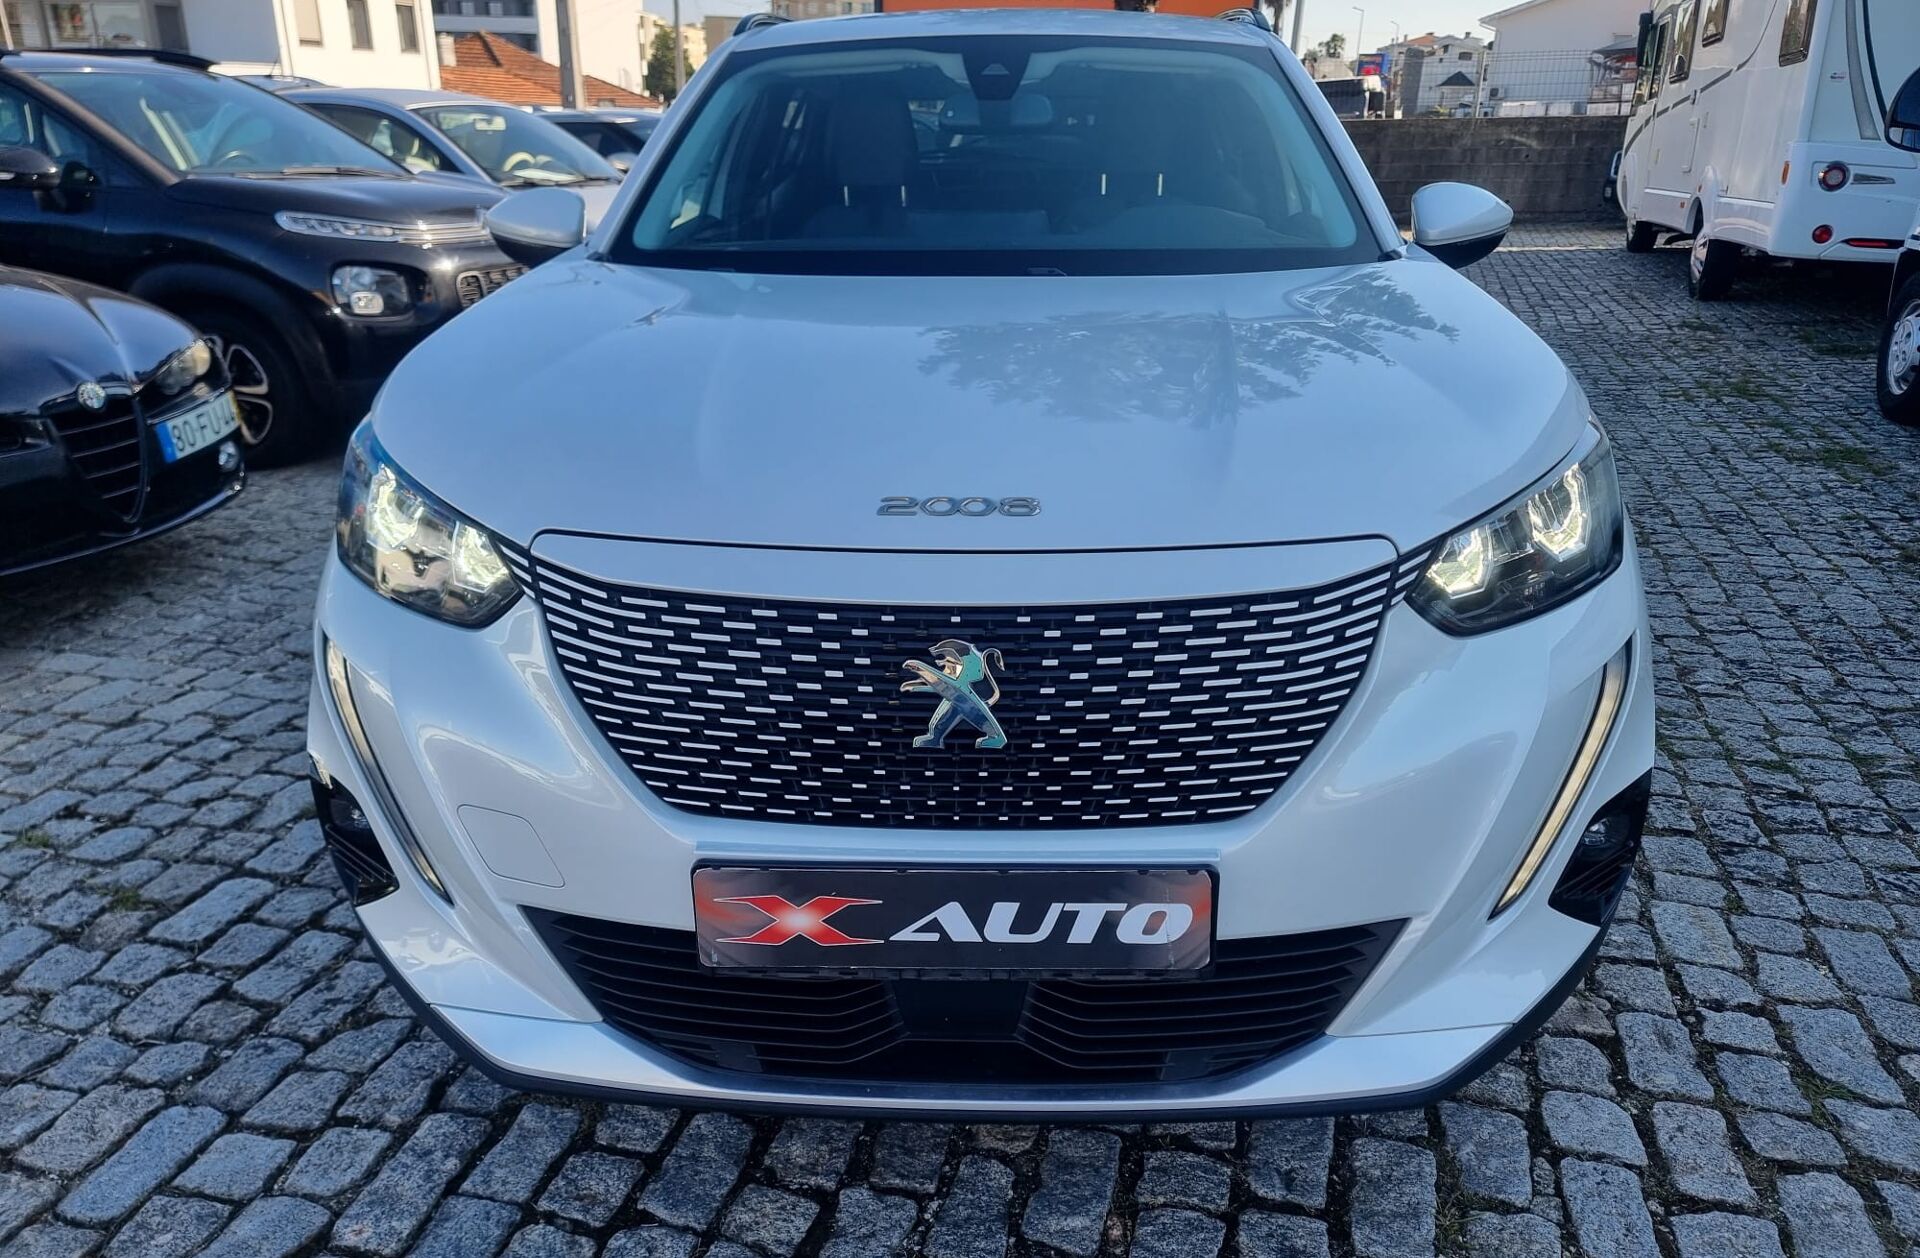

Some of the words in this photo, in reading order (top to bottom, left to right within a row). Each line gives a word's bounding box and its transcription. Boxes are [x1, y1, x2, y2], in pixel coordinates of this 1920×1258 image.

[877, 496, 1042, 516] 2008
[713, 895, 884, 945] X
[889, 901, 1193, 944] AUTO
